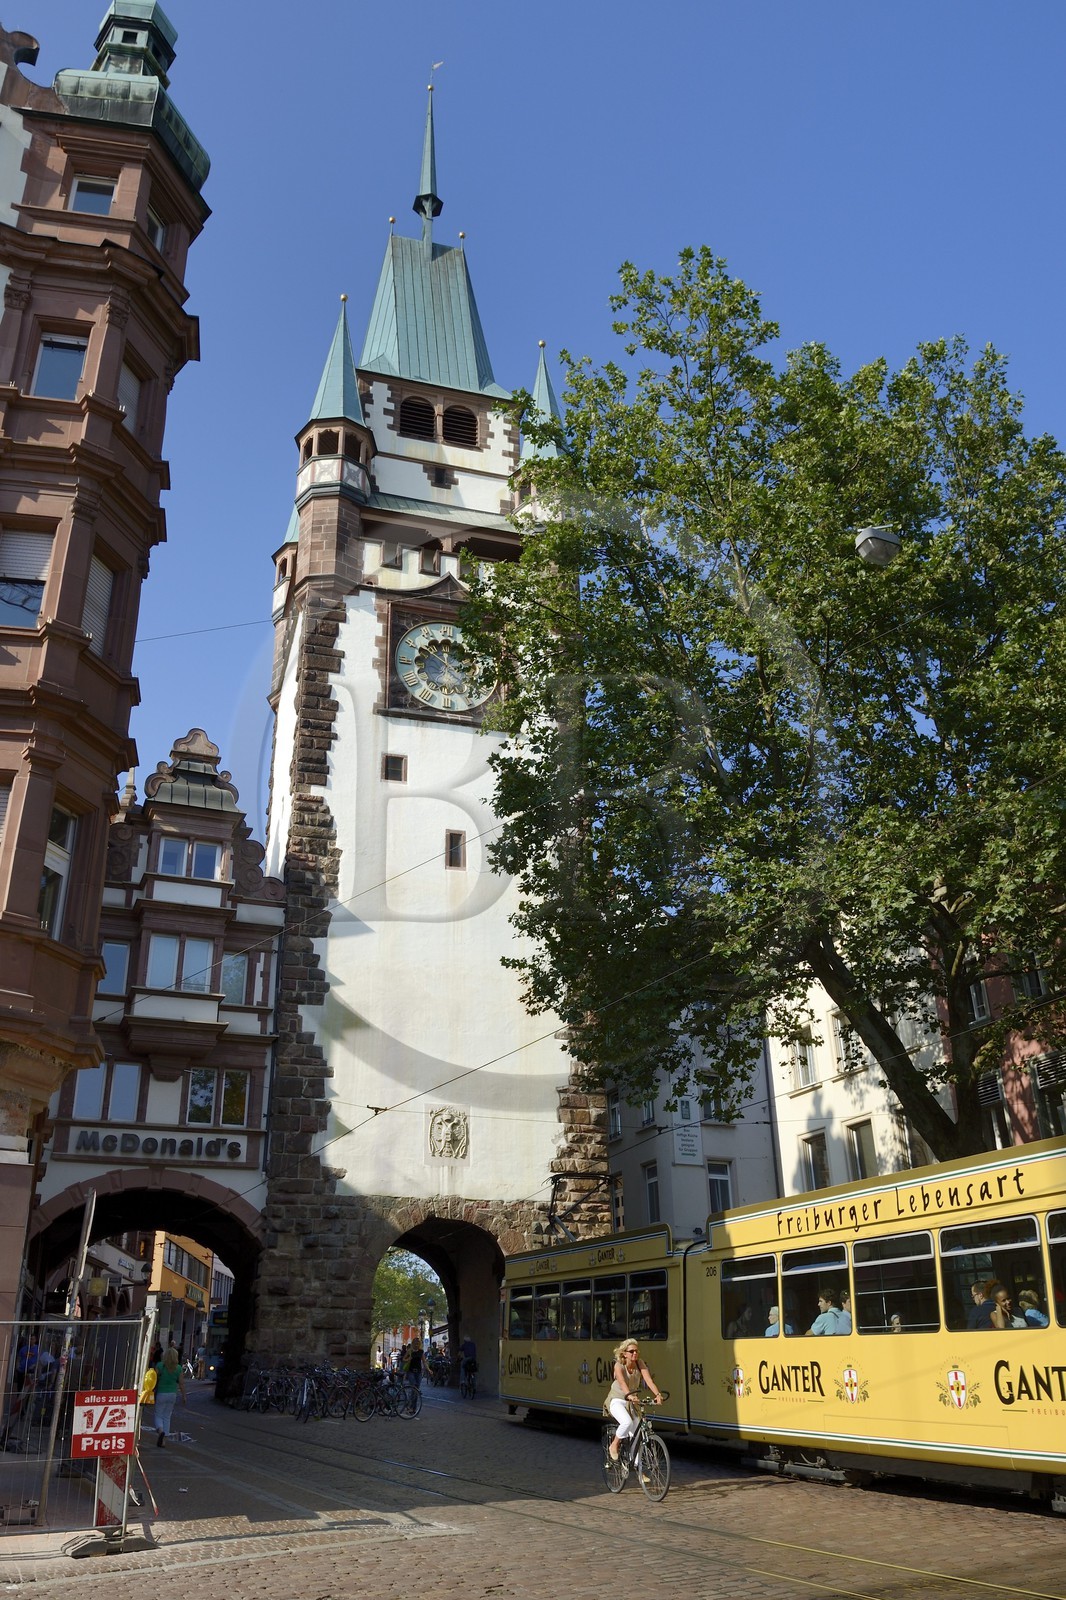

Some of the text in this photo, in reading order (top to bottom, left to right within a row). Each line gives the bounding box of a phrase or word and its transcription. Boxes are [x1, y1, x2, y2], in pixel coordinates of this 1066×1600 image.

[76, 1130, 242, 1161] McDonald's
[776, 1168, 1025, 1233] Freiburger Lebensart
[597, 1248, 615, 1263] GANTER
[705, 1266, 718, 1277] 206
[508, 1354, 533, 1377] GANTER
[595, 1358, 615, 1384] GAN
[758, 1360, 826, 1397] GANTER
[994, 1359, 1066, 1405] GANT
[84, 1395, 128, 1404] alles zum
[83, 1406, 127, 1433] 1/2
[81, 1435, 126, 1452] Preis
